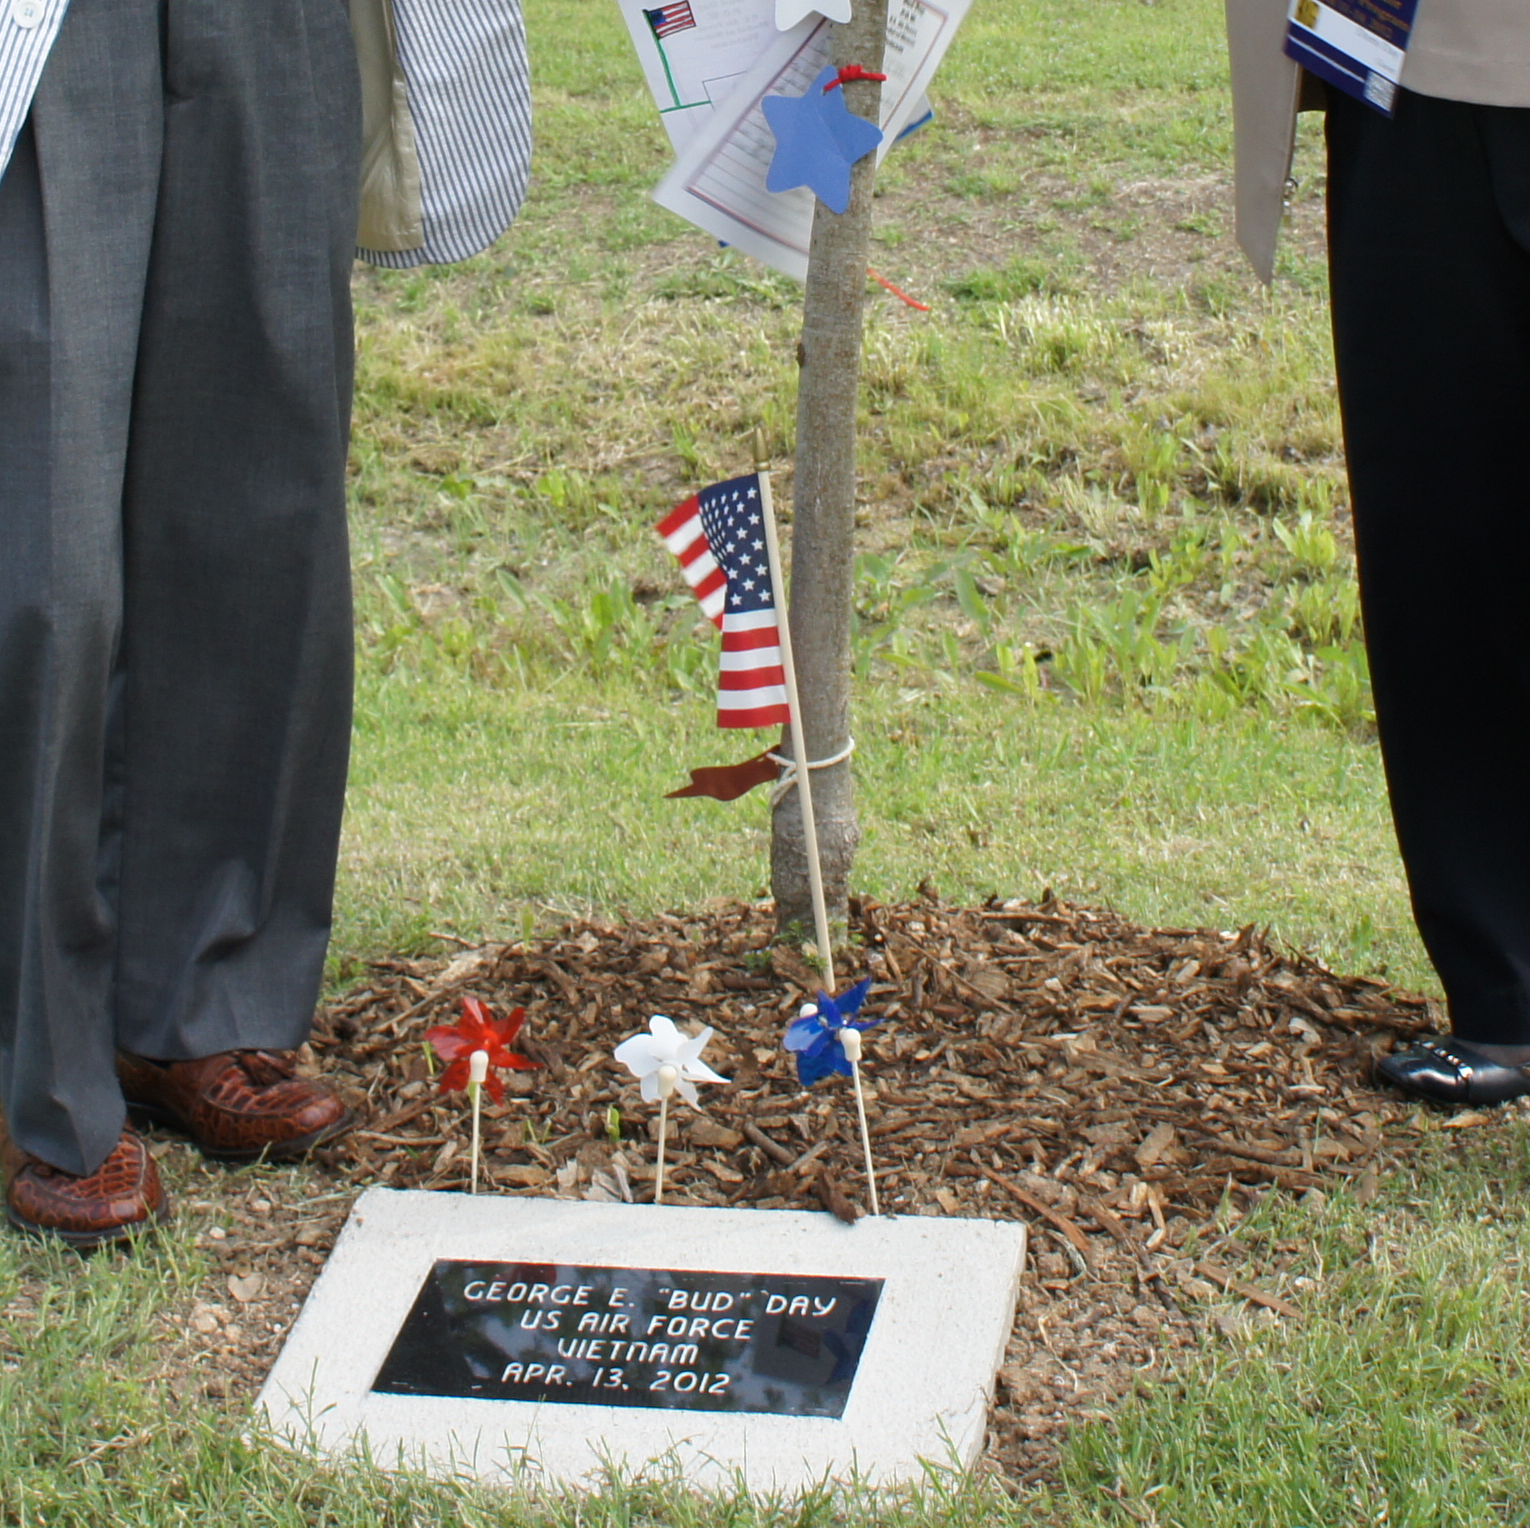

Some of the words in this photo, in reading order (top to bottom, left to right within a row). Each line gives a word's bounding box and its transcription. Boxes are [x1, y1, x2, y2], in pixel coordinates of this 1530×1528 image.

[463, 1280, 594, 1306] GEORGE
[608, 1287, 635, 1308] E.
[658, 1287, 751, 1312] "BUD"
[765, 1293, 837, 1317] DAY
[520, 1308, 562, 1330] US
[577, 1311, 631, 1334] AIR
[646, 1314, 754, 1340] FORCE
[557, 1337, 699, 1365] VIETNAM
[501, 1361, 573, 1386] APR.
[649, 1370, 731, 1395] 2012
